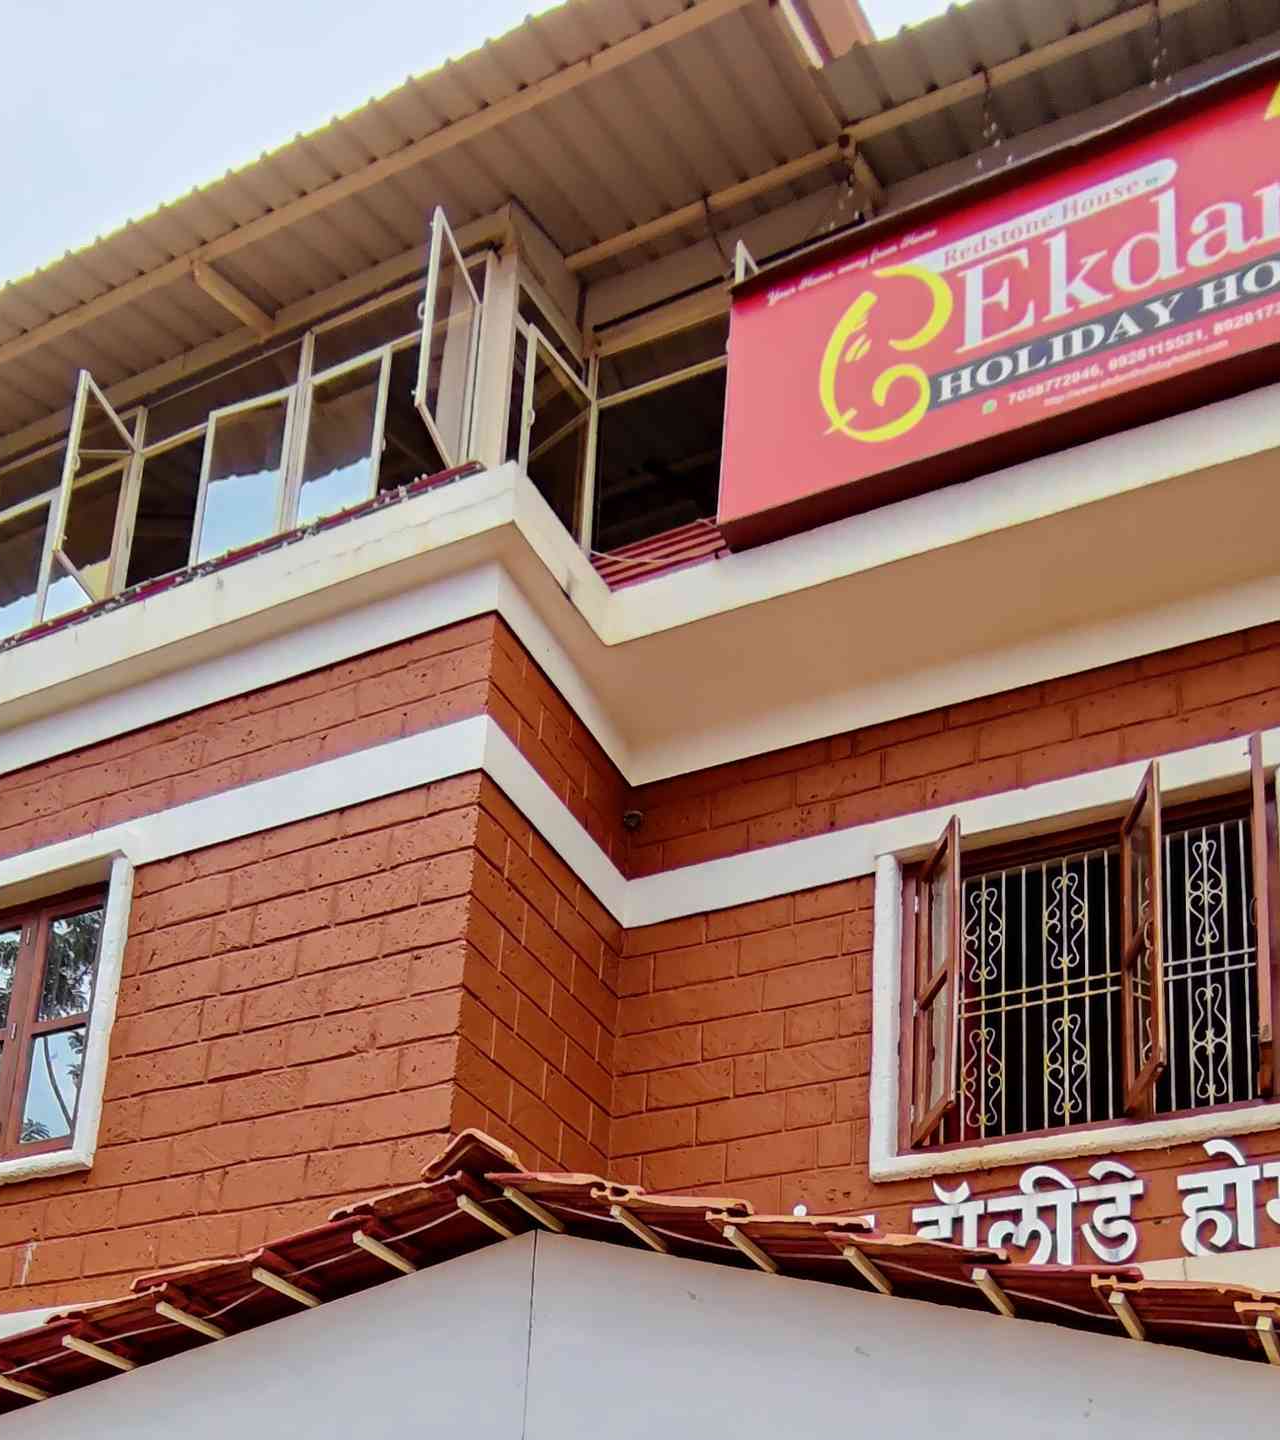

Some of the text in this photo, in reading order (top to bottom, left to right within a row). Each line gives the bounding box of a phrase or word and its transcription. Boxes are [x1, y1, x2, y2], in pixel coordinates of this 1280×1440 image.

[943, 180, 1140, 267] Redstone House
[938, 297, 1189, 403] HOLIDAY
